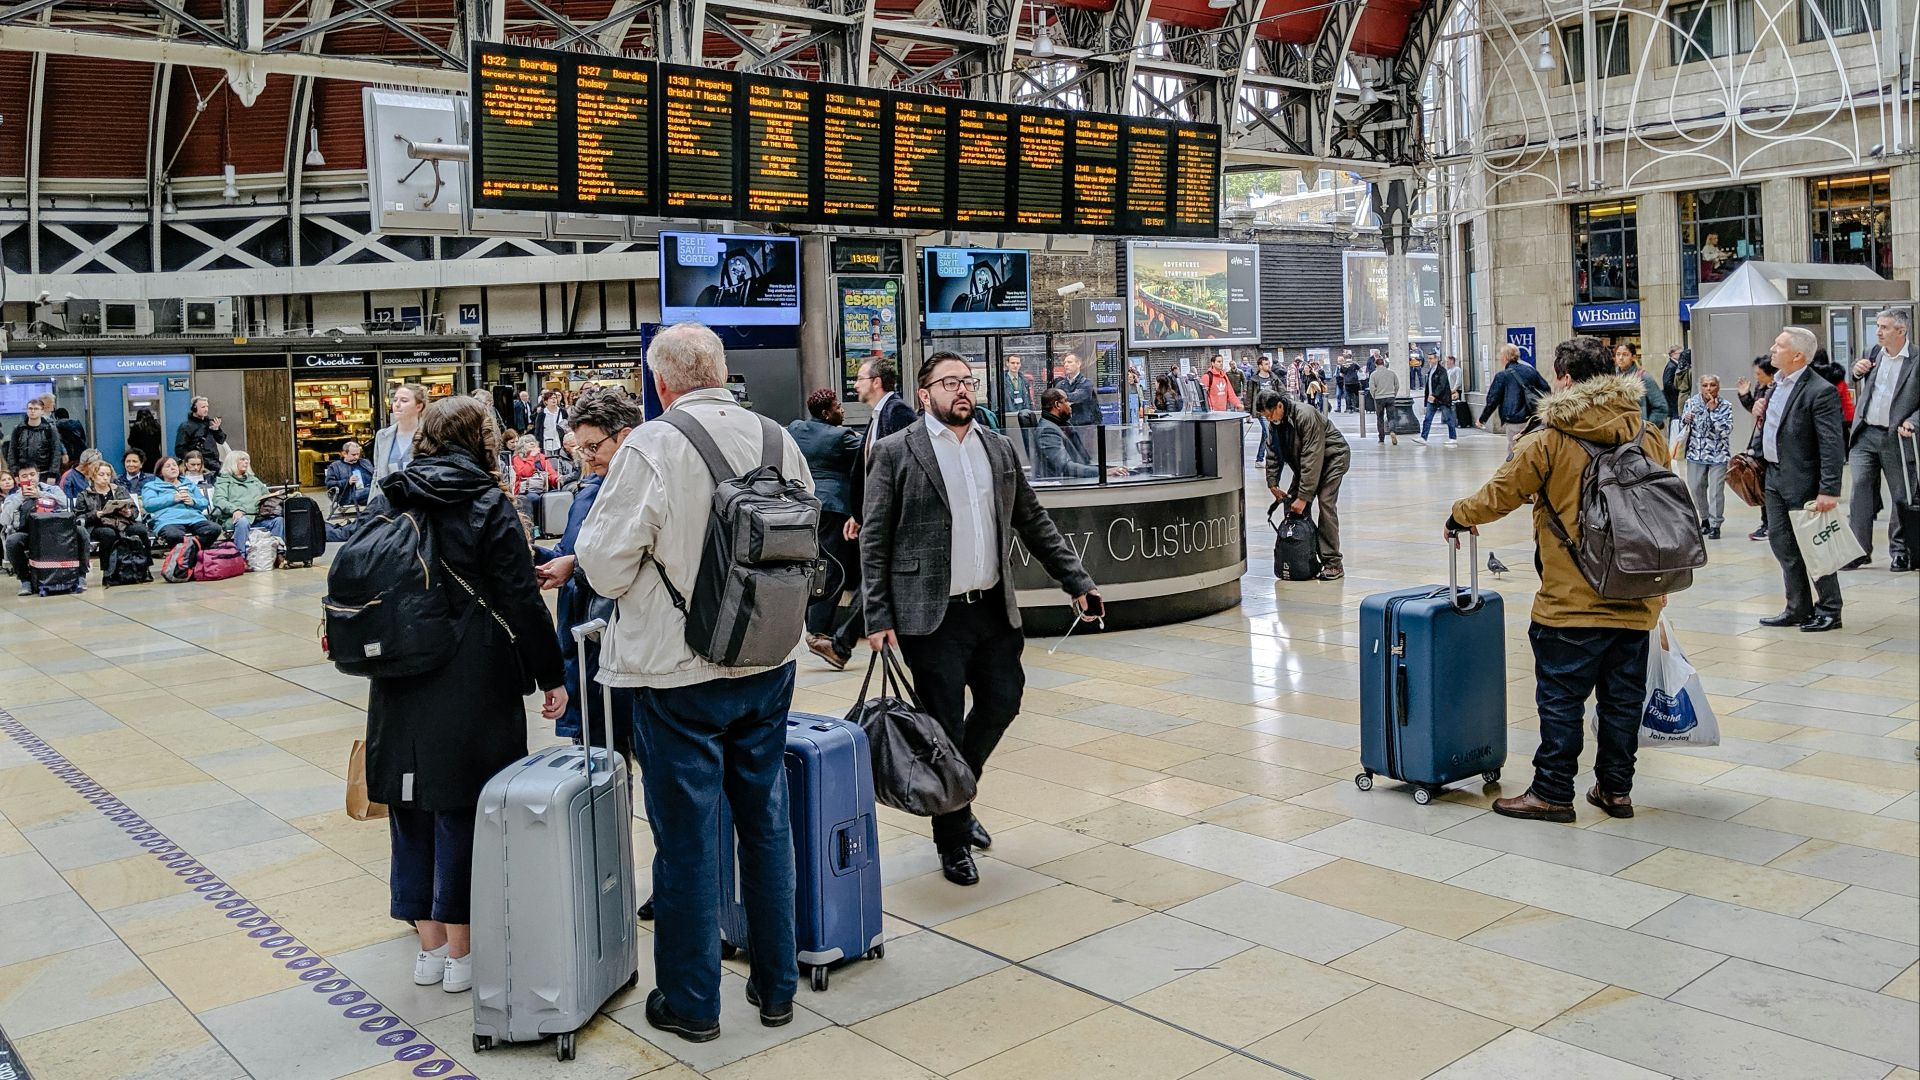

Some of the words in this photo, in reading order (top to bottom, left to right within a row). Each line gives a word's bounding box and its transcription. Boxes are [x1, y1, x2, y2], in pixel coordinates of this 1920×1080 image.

[483, 55, 507, 66] 13:22
[520, 59, 557, 72] Boarding
[578, 66, 600, 76] 13:27
[612, 69, 648, 83] Boarding
[577, 78, 608, 90] Cholsey
[668, 76, 689, 86] 13:30
[696, 79, 732, 91] Preparing
[668, 87, 693, 98] Bristol
[704, 92, 726, 101] Meads
[750, 85, 769, 95] 13:33
[783, 89, 793, 97] Pls
[499, 101, 532, 110] Charlbury
[599, 103, 628, 111] Broadway
[750, 97, 782, 108] Heathrow
[785, 101, 801, 110] T234
[896, 102, 912, 111] 13:42
[605, 111, 637, 119] Harlington
[825, 105, 860, 116] Cheltenham
[863, 109, 874, 118] Spa
[594, 118, 619, 126] Drayton
[895, 113, 920, 122] Twyford
[578, 132, 602, 140] Langley
[578, 148, 613, 156] Maidenhead
[578, 163, 602, 171] Reading
[697, 238, 706, 246] IT.
[680, 246, 696, 254] SAY
[680, 255, 716, 263] SORTED.
[845, 295, 893, 308] escape
[1090, 301, 1121, 313] Paddington
[377, 311, 390, 322] 12
[462, 308, 476, 319] 14
[1096, 313, 1117, 324] Station
[1577, 308, 1636, 322] WHSmith
[1509, 334, 1533, 345] WH
[306, 356, 364, 366] Chocolat.
[1107, 511, 1241, 562] Customer
[1649, 732, 1666, 740] Join
